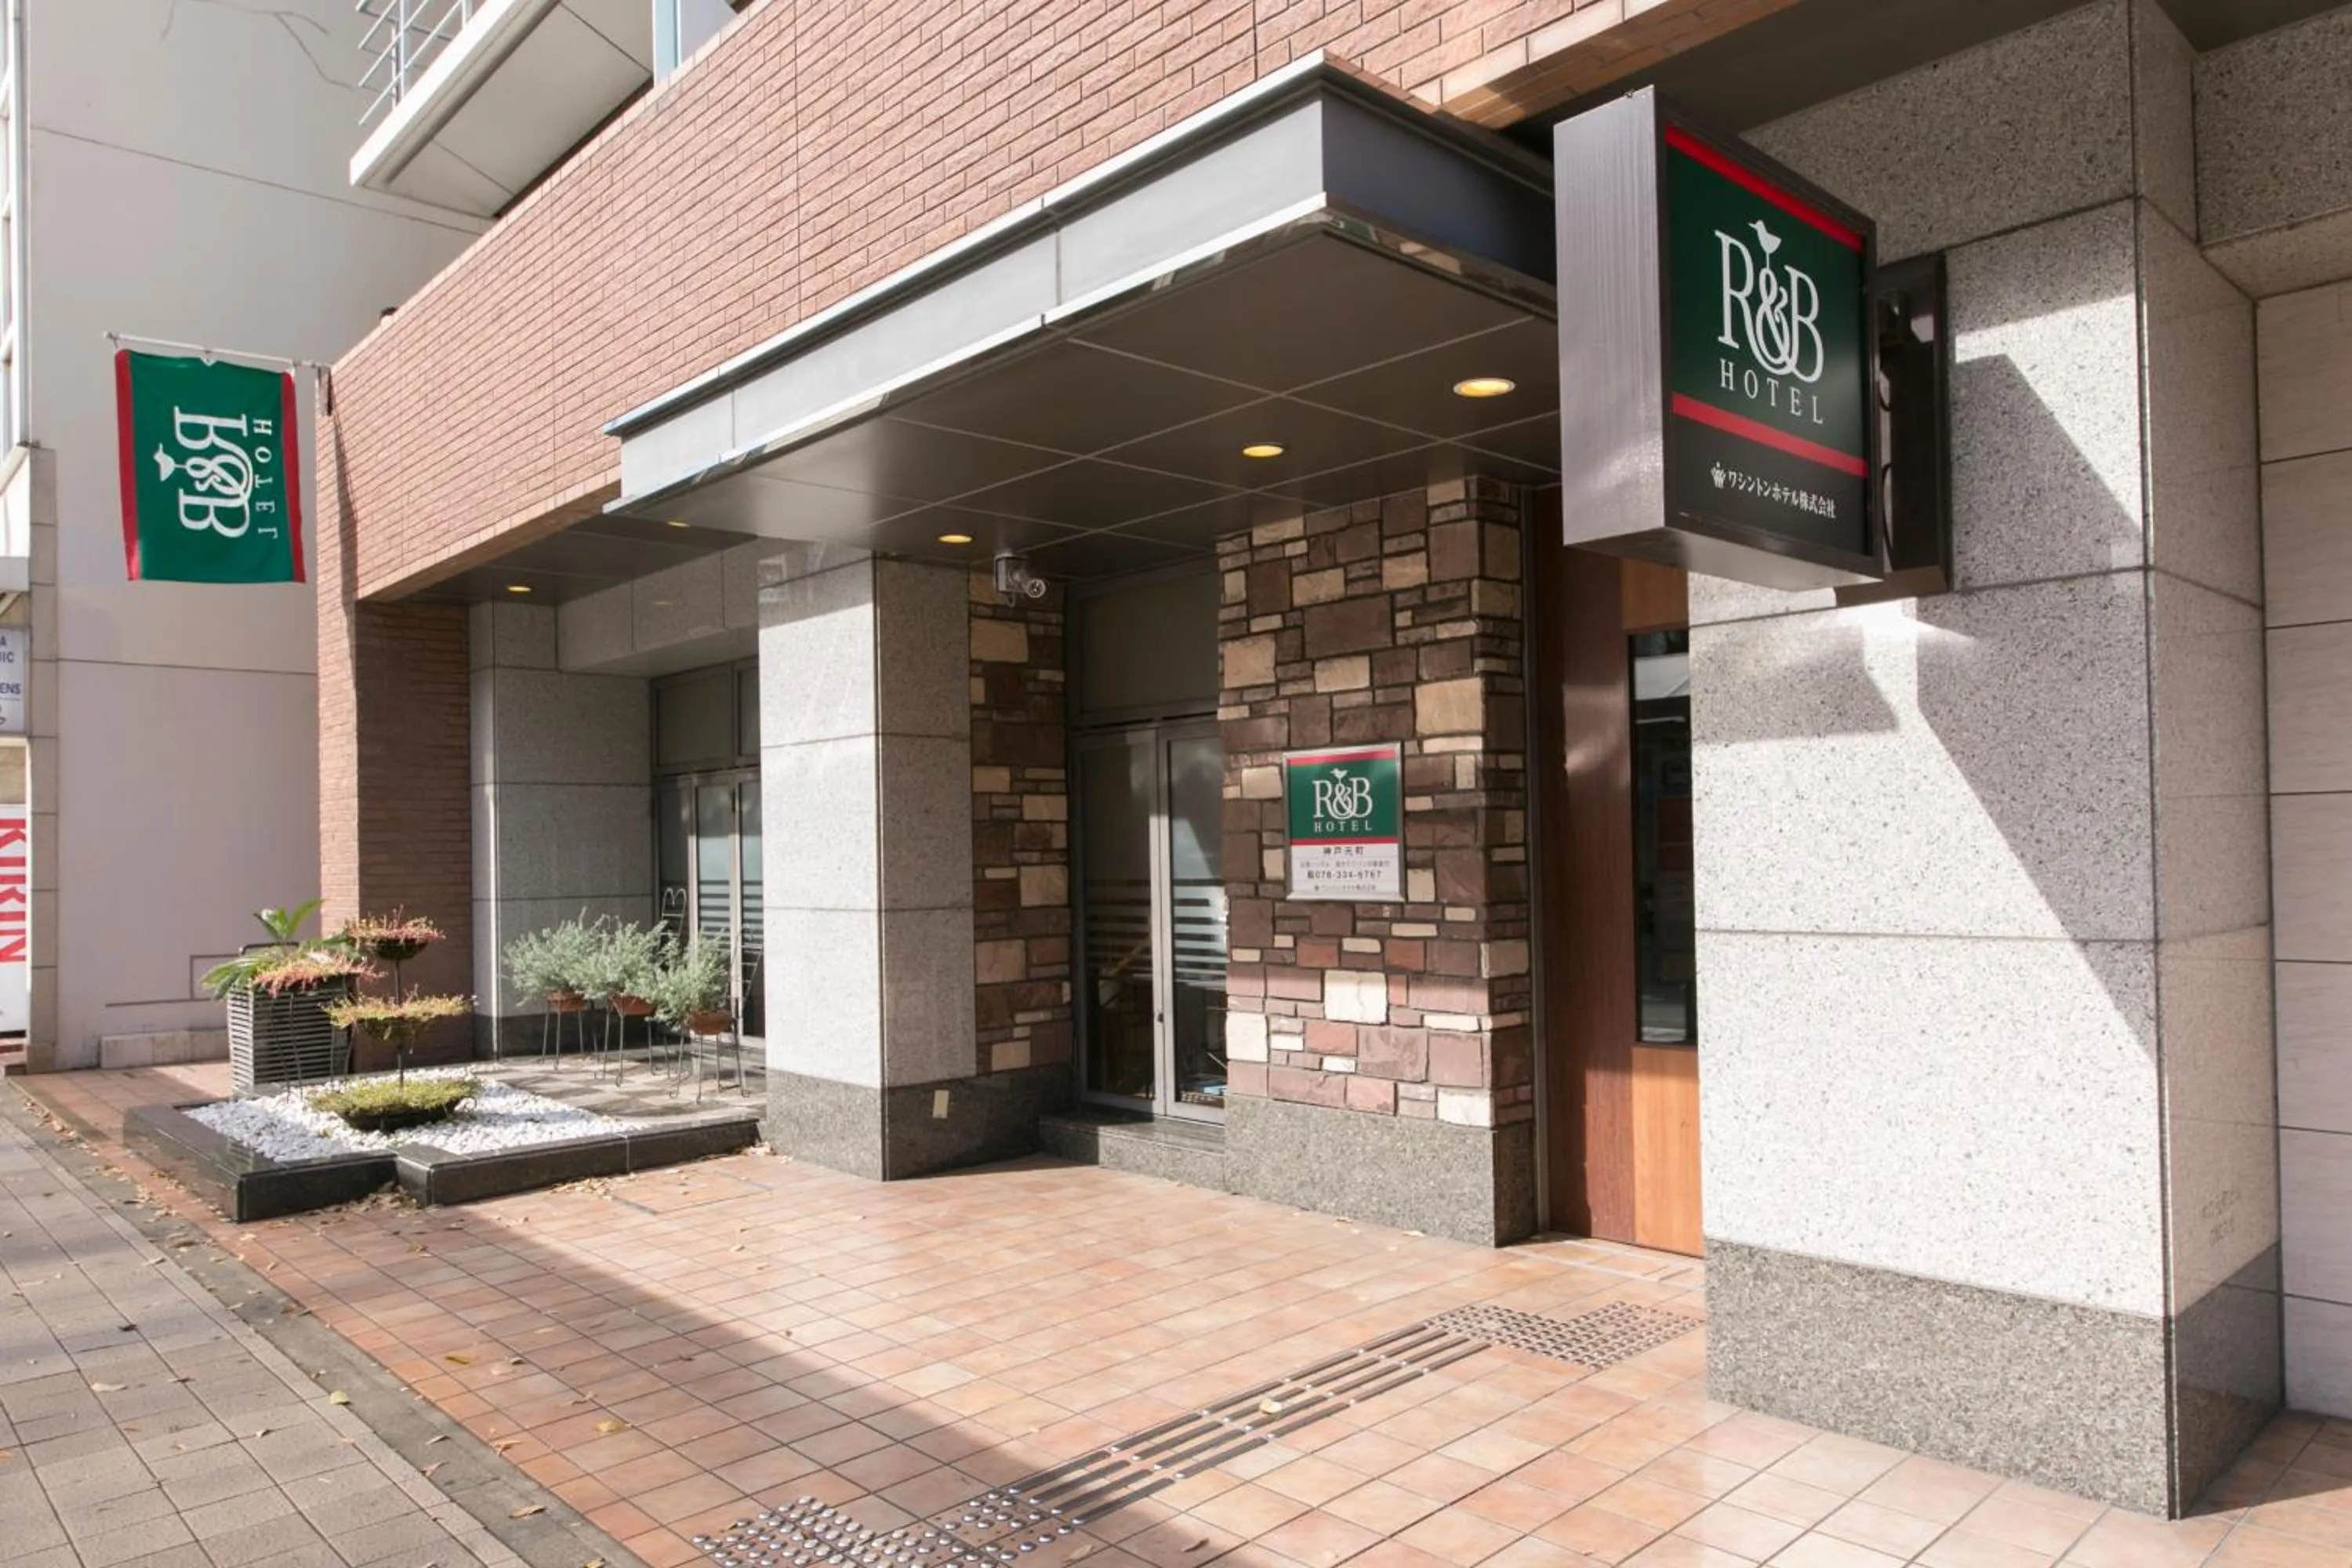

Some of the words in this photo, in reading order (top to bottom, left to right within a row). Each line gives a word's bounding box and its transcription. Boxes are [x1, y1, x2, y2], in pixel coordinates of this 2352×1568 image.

[1714, 229, 1824, 383] R&B
[1719, 358, 1824, 424] HOTEL
[1728, 470, 1836, 519] ワシントンホテル株式会社
[1312, 776, 1374, 820] R&B
[1313, 819, 1373, 833] HOTEL
